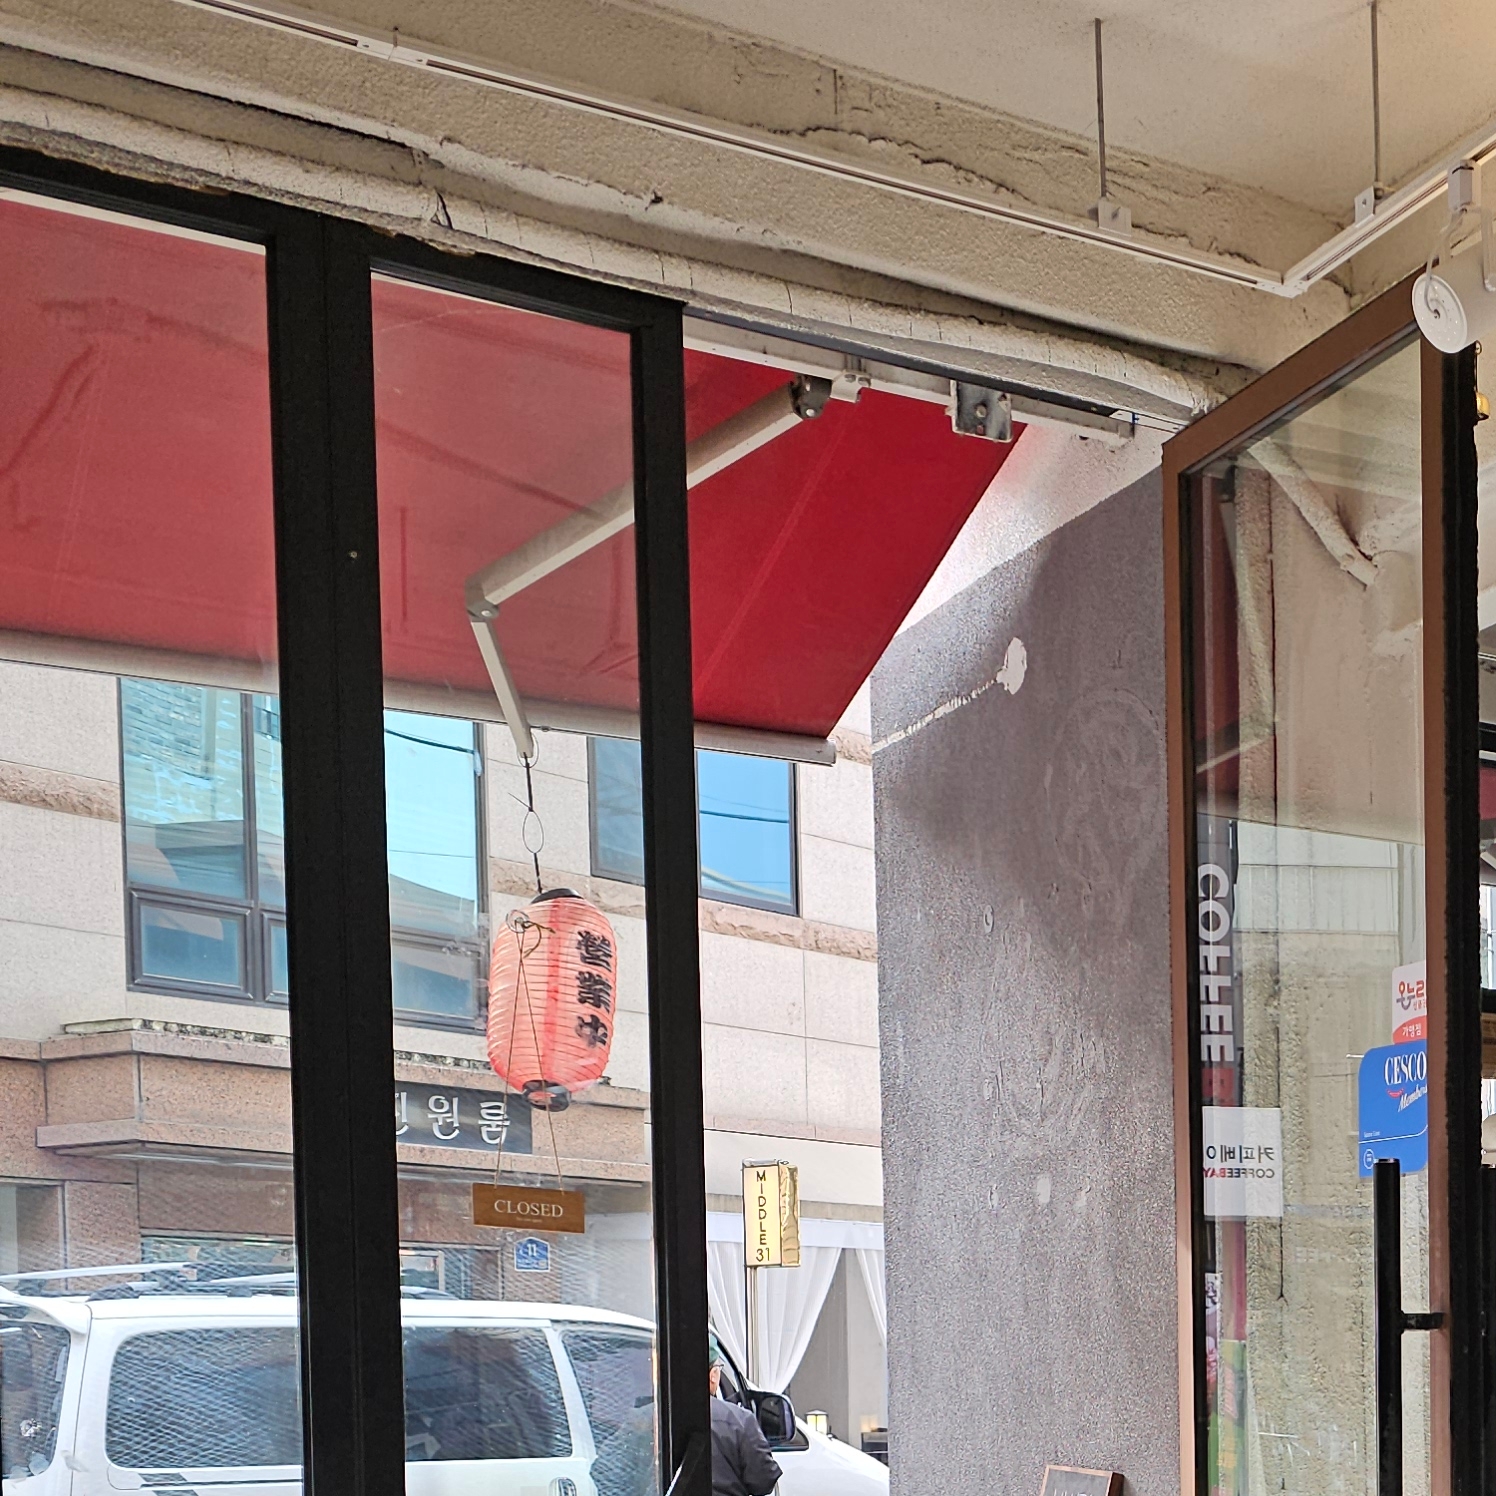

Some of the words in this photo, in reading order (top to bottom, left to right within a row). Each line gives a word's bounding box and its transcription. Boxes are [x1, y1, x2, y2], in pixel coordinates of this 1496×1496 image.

[1402, 1023, 1421, 1037] 가맹점
[1384, 1051, 1427, 1086] CESCO
[494, 1200, 563, 1217] CLOSED
[756, 1170, 767, 1245] MIDDLE
[756, 1247, 770, 1262] 31
